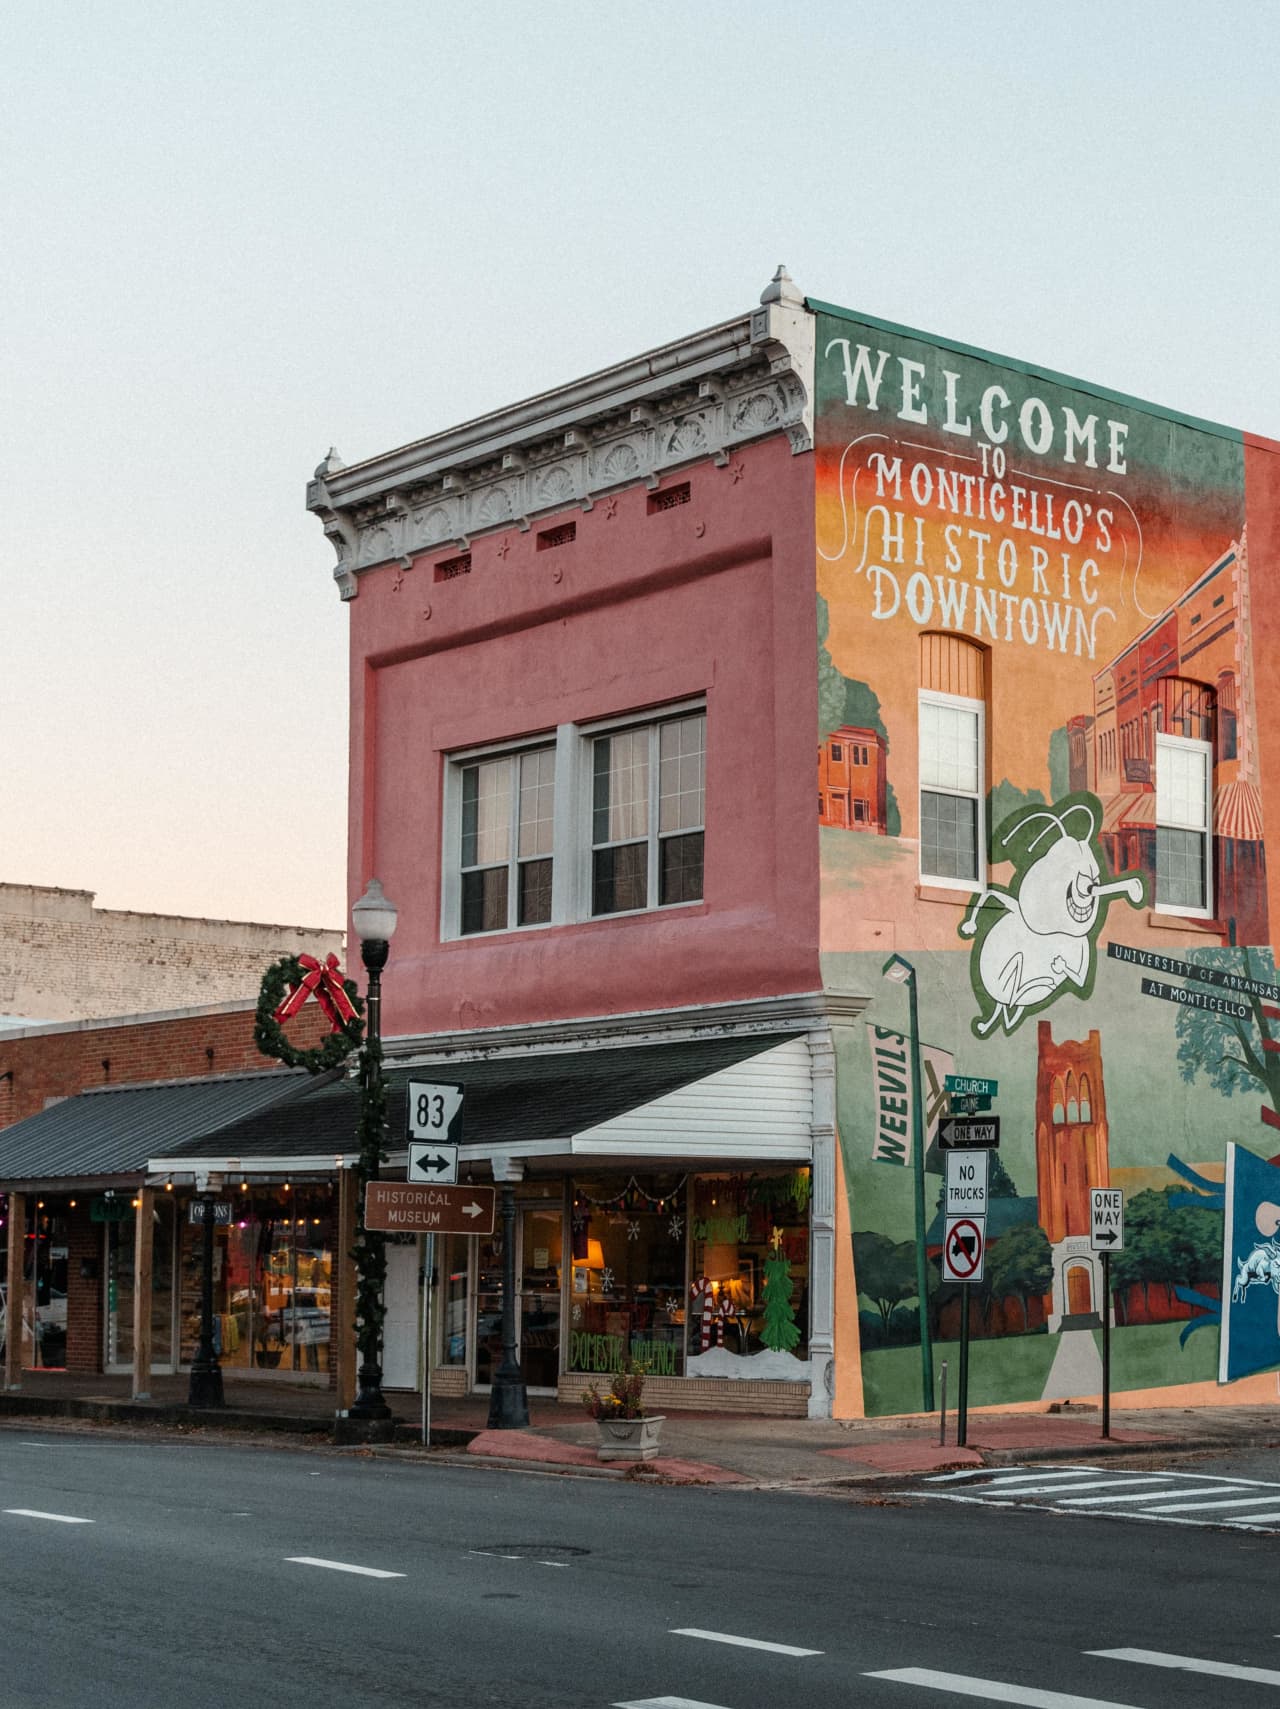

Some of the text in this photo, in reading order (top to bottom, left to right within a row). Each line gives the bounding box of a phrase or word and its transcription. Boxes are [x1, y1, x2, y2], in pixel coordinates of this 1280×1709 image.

[825, 338, 1129, 475] WELCOME
[976, 441, 1007, 479] TO
[867, 451, 1115, 553] MONTICELLO'S
[855, 504, 1101, 605] HISTORIC
[865, 563, 1117, 660] DOWNTOWN
[1115, 945, 1279, 1000] UNIVERSITY OF ARKANSAS
[1148, 982, 1246, 1017] AT MONTICELLO
[874, 1025, 908, 1166] WEEVILS
[954, 1077, 988, 1093] CHURCH
[416, 1093, 445, 1129] 83
[954, 1126, 993, 1140] ONE WAY
[959, 1165, 975, 1181] NO
[193, 1204, 229, 1217] OPONS
[377, 1189, 452, 1206] HISTORICAL
[949, 1187, 985, 1200] TRUCKS
[1094, 1193, 1120, 1209] ONE
[388, 1210, 441, 1225] MUSEUM
[1094, 1211, 1121, 1226] WAY
[569, 1328, 626, 1373] DOMESTIC
